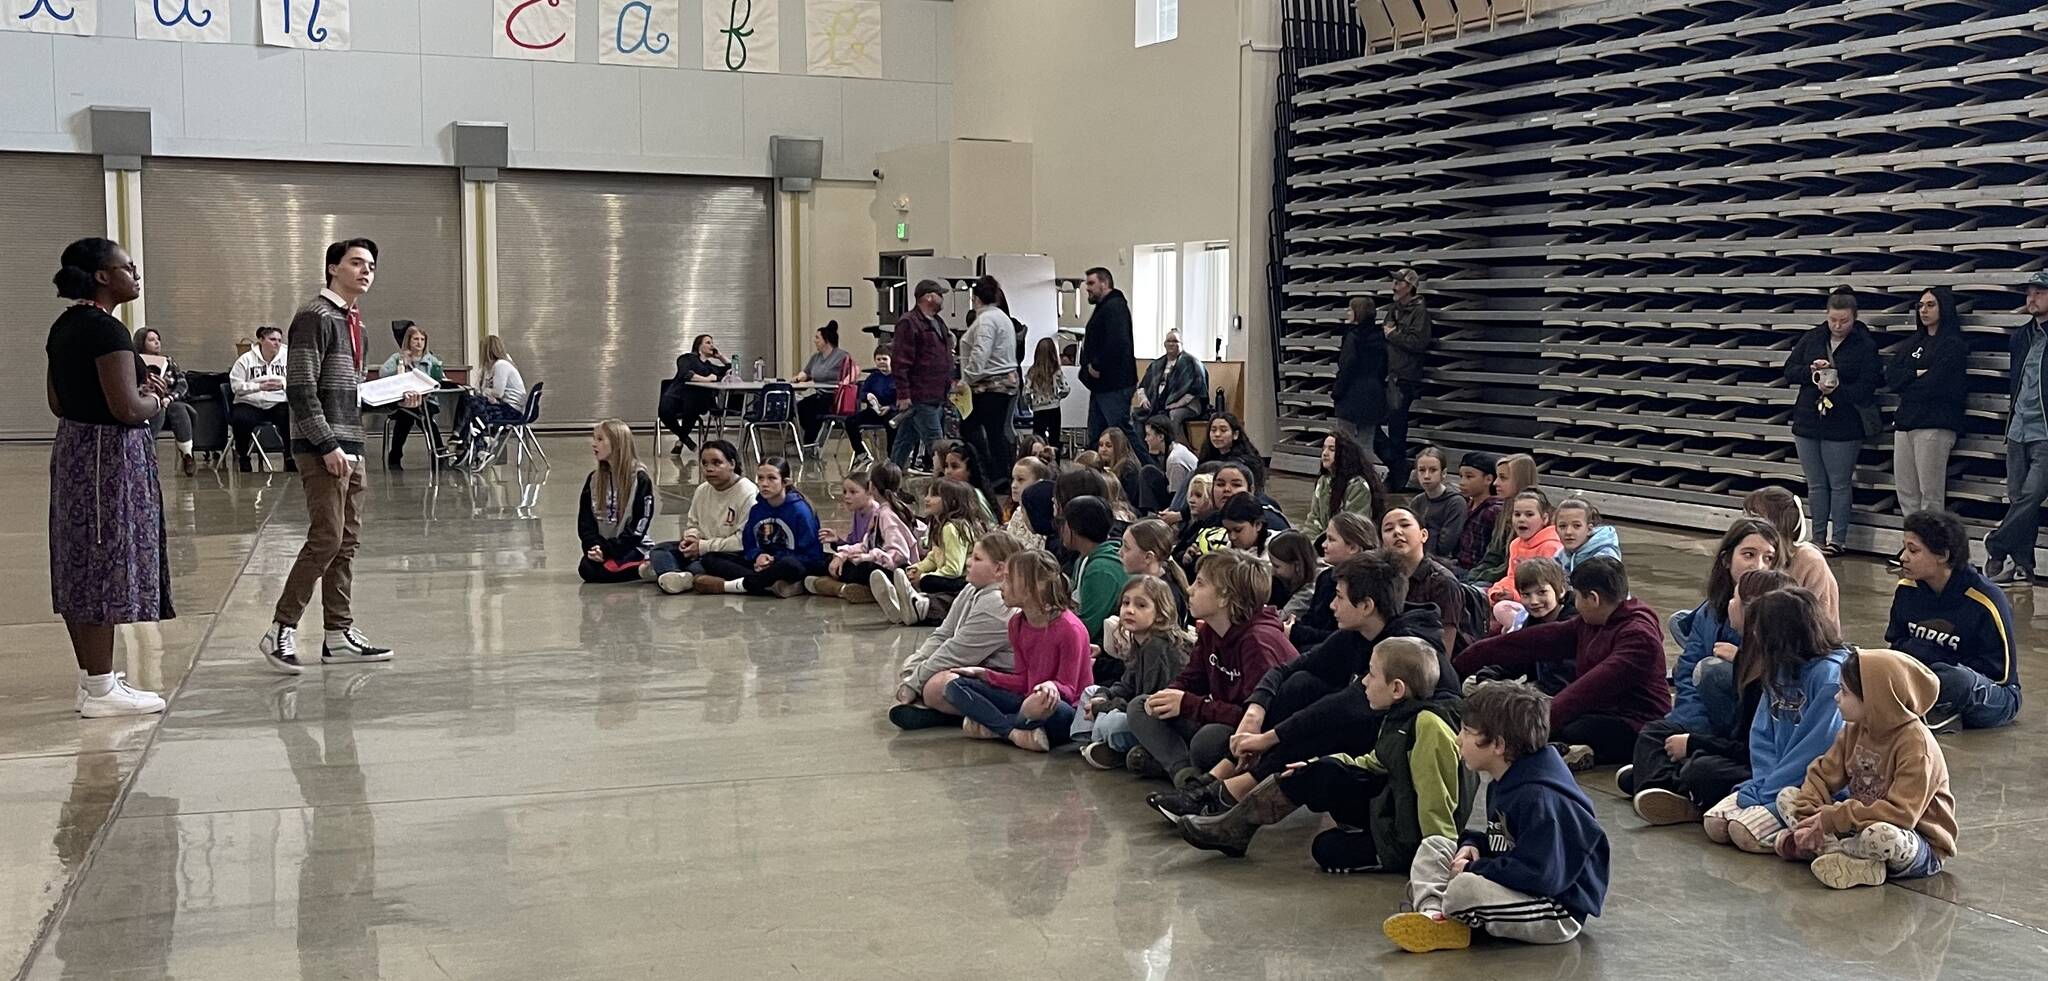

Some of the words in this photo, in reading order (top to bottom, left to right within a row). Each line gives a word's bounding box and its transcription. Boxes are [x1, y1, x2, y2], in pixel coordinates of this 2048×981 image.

[250, 364, 268, 380] NEW
[271, 364, 288, 377] YOR
[1907, 621, 1961, 651] FORKS
